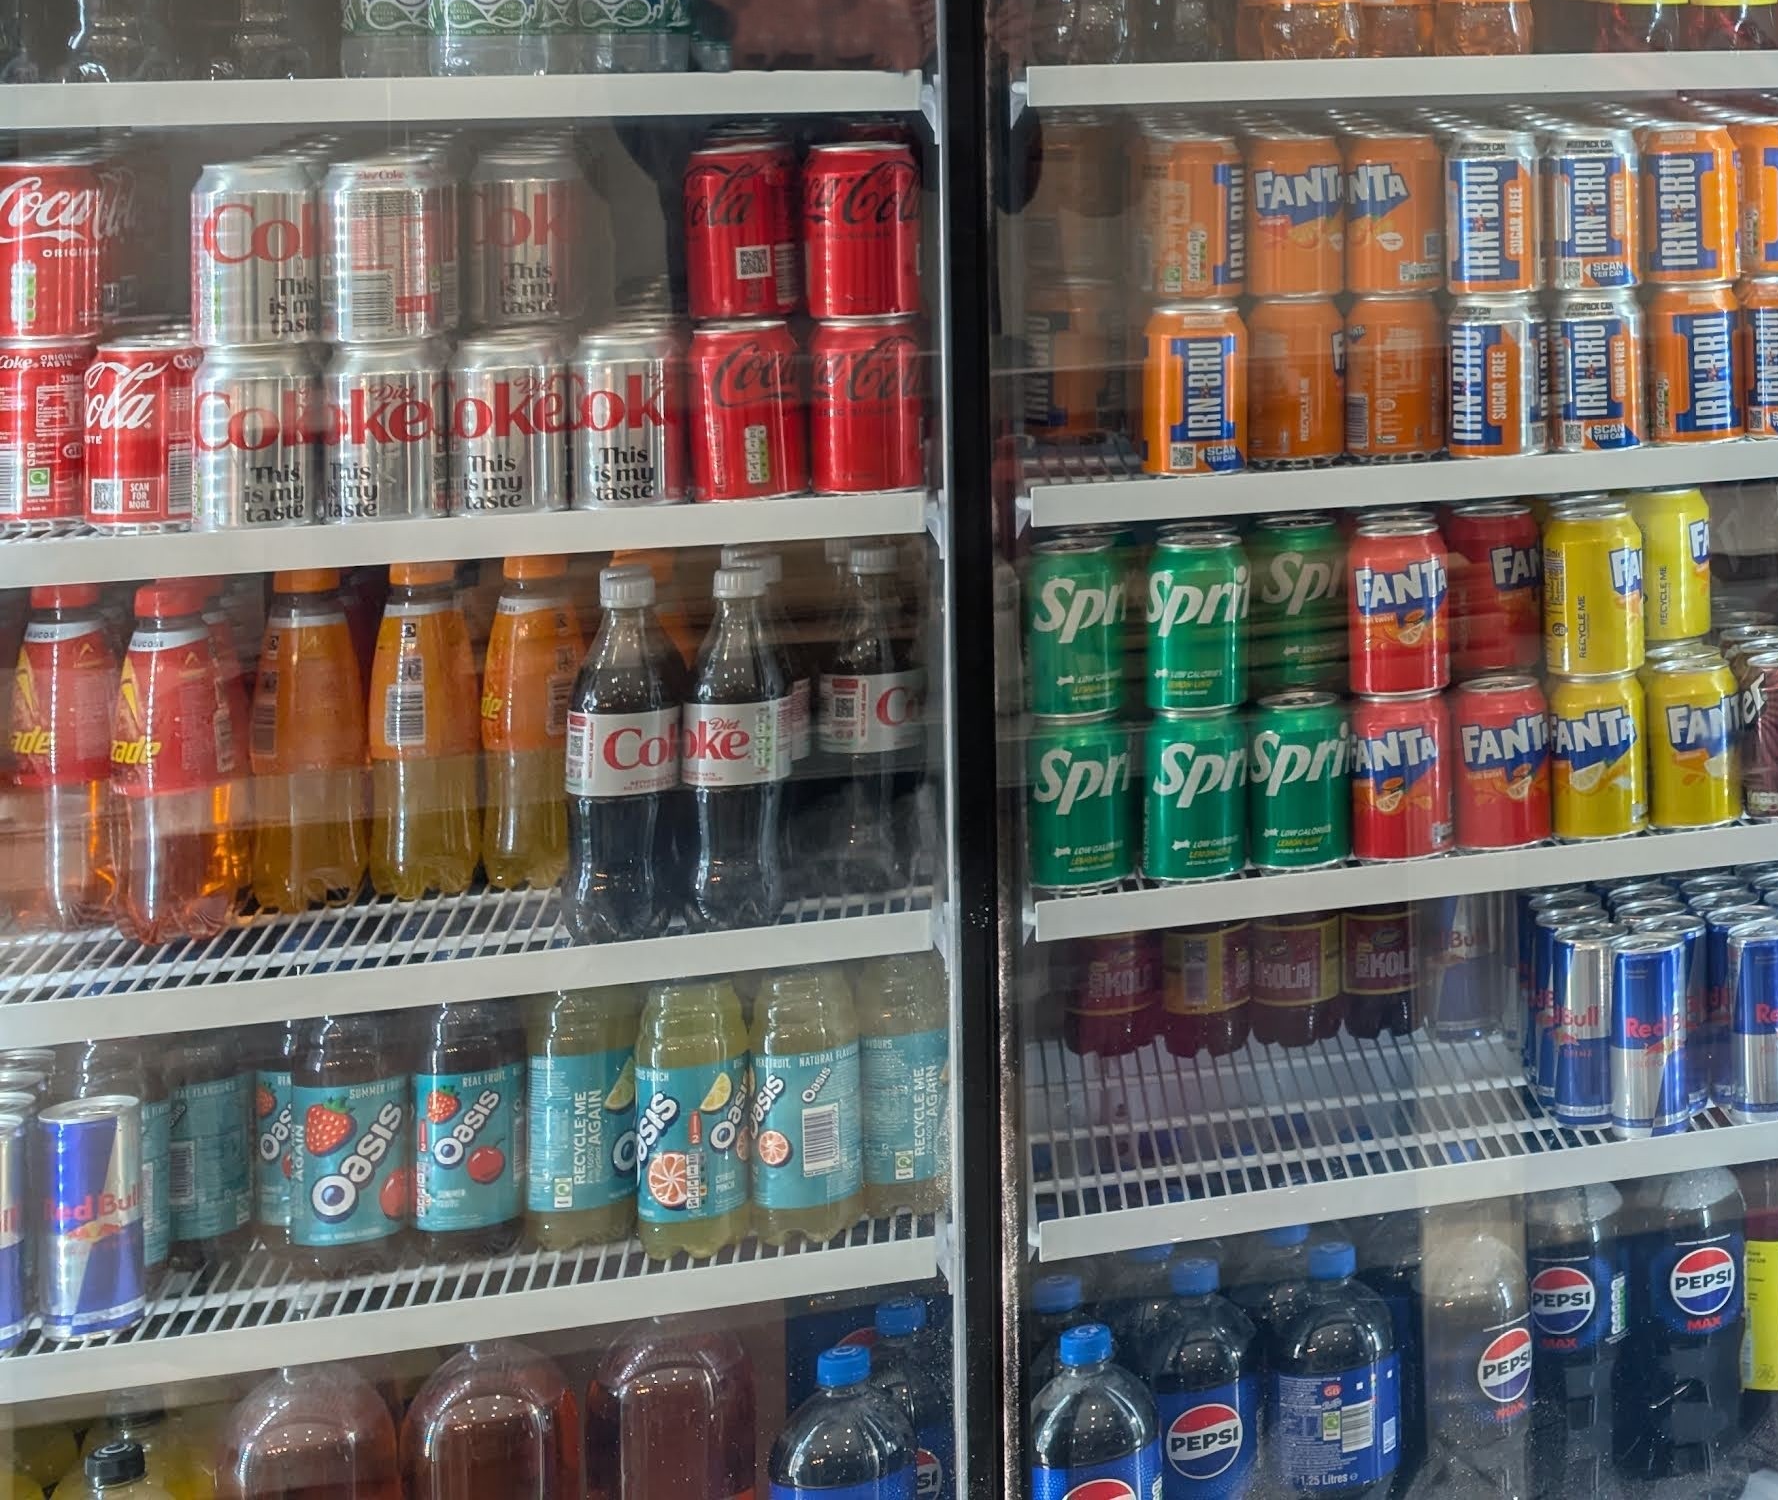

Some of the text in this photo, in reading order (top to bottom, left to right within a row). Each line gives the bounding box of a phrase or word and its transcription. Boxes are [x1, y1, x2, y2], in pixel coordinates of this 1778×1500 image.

[1598, 139, 1614, 149] CAN
[1612, 178, 1625, 237] SUGAR FREE
[1508, 185, 1523, 256] SUGAR FREE
[1592, 260, 1625, 272] SCAN
[1592, 268, 1625, 278] YER CAN
[1614, 340, 1626, 399] SUGAR FREE
[1492, 350, 1507, 421] SUGAR FREE
[1592, 423, 1626, 435] SCAN
[1592, 430, 1626, 441] YER CAN
[599, 446, 649, 465] This
[1206, 445, 1237, 457] SCAN
[467, 454, 516, 473] This
[250, 464, 300, 484] This
[463, 473, 523, 494] is my
[594, 465, 655, 486] is my
[130, 483, 149, 491] SCAN
[244, 488, 265, 503] is
[595, 481, 655, 502] taste
[129, 501, 150, 509] MORE
[244, 501, 304, 522] taste
[465, 492, 523, 511] taste
[1354, 559, 1447, 608] FANTA
[1659, 566, 1668, 629] RECYCLE ME
[1579, 594, 1587, 659] RECYCLE ME
[709, 717, 742, 731] Diet
[1625, 1016, 1667, 1038] Red
[802, 1067, 832, 1102] Oasis
[914, 1067, 925, 1157] RECYCLE ME
[434, 1089, 500, 1165] Oasis
[1675, 1268, 1733, 1292] PEPSI
[1533, 1290, 1591, 1309] PEPSI
[1687, 1314, 1722, 1332] MAX
[1541, 1337, 1577, 1350] MAX
[1495, 1400, 1526, 1420] MAX
[1170, 1426, 1240, 1453] PEPSI
[1300, 1472, 1348, 1486] 1.25 Litres
